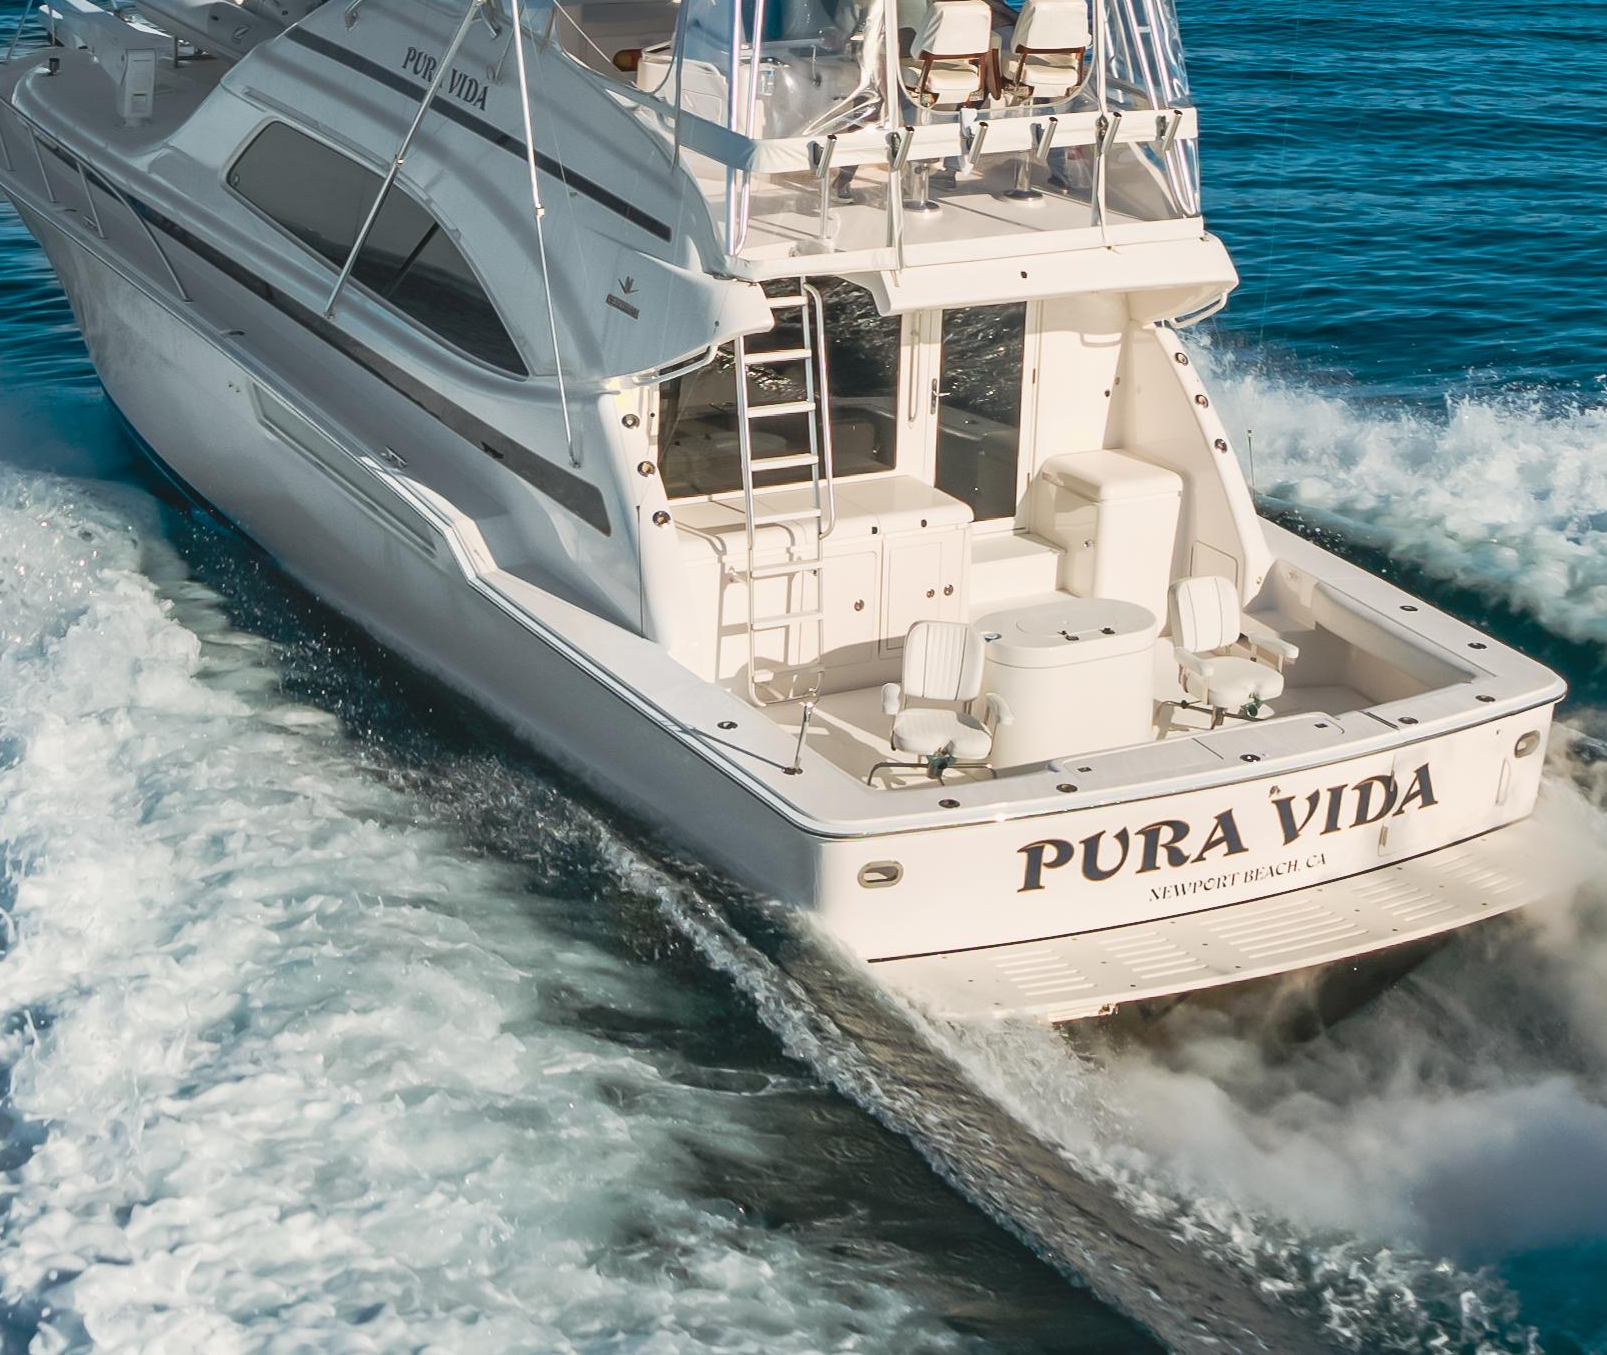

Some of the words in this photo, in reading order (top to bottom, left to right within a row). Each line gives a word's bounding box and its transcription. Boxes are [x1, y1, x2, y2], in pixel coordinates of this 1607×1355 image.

[402, 46, 443, 89] PUR
[448, 68, 489, 112] VIDA
[1017, 808, 1249, 893] PURA
[1271, 762, 1439, 847] VIDA
[1149, 871, 1240, 902] NEWPORT
[1306, 853, 1327, 868] CA
